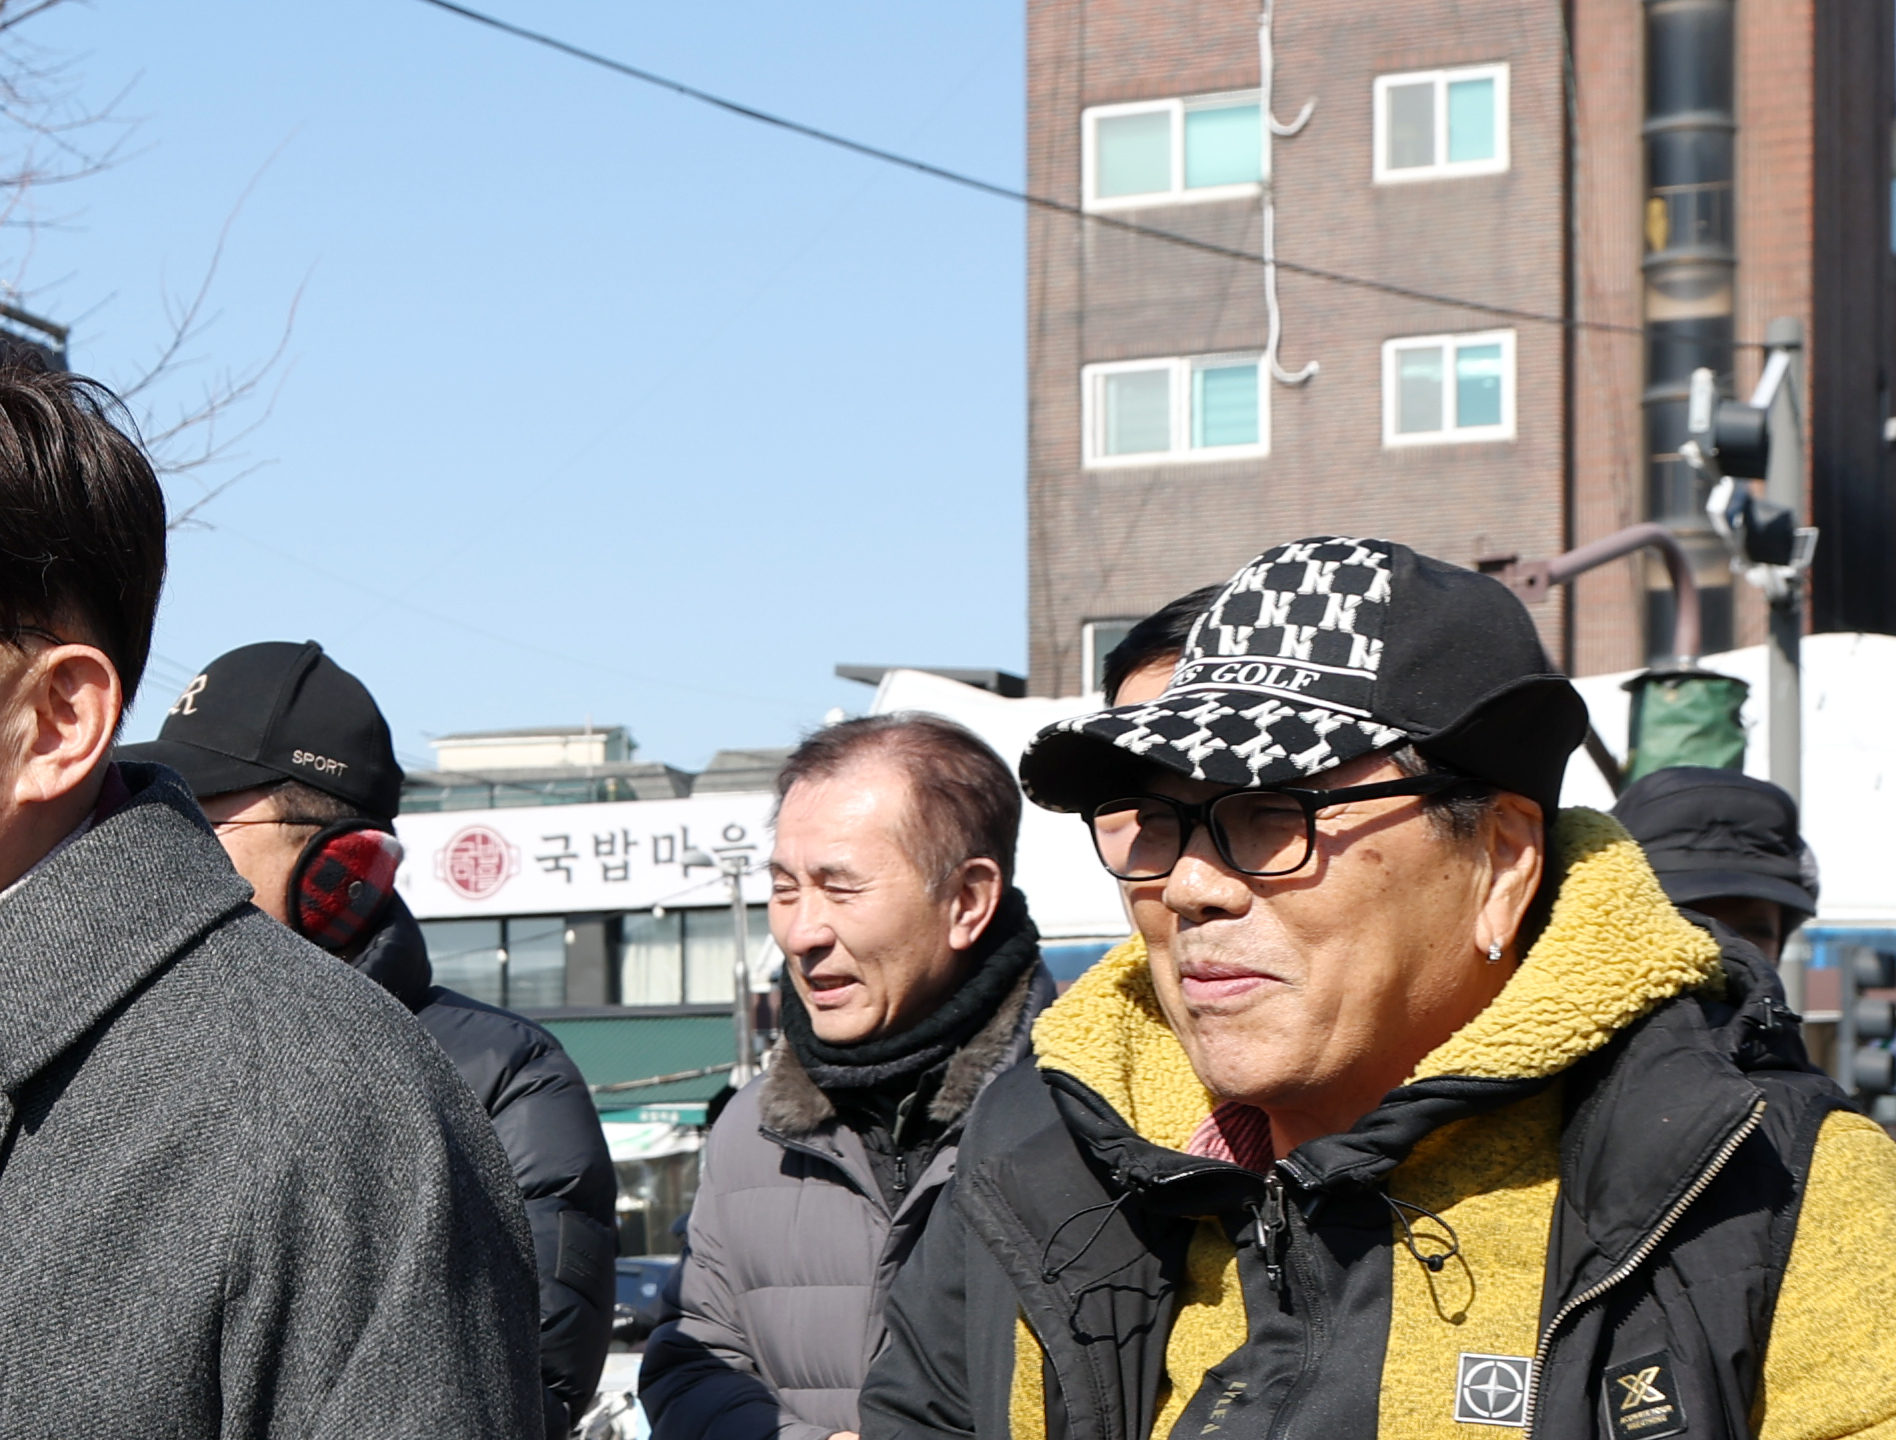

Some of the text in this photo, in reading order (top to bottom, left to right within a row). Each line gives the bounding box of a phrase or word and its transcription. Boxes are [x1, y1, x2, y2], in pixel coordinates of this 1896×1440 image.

[1211, 663, 1321, 692] GOLF
[291, 749, 349, 777] SPORT
[534, 823, 759, 884] 국밥마을
